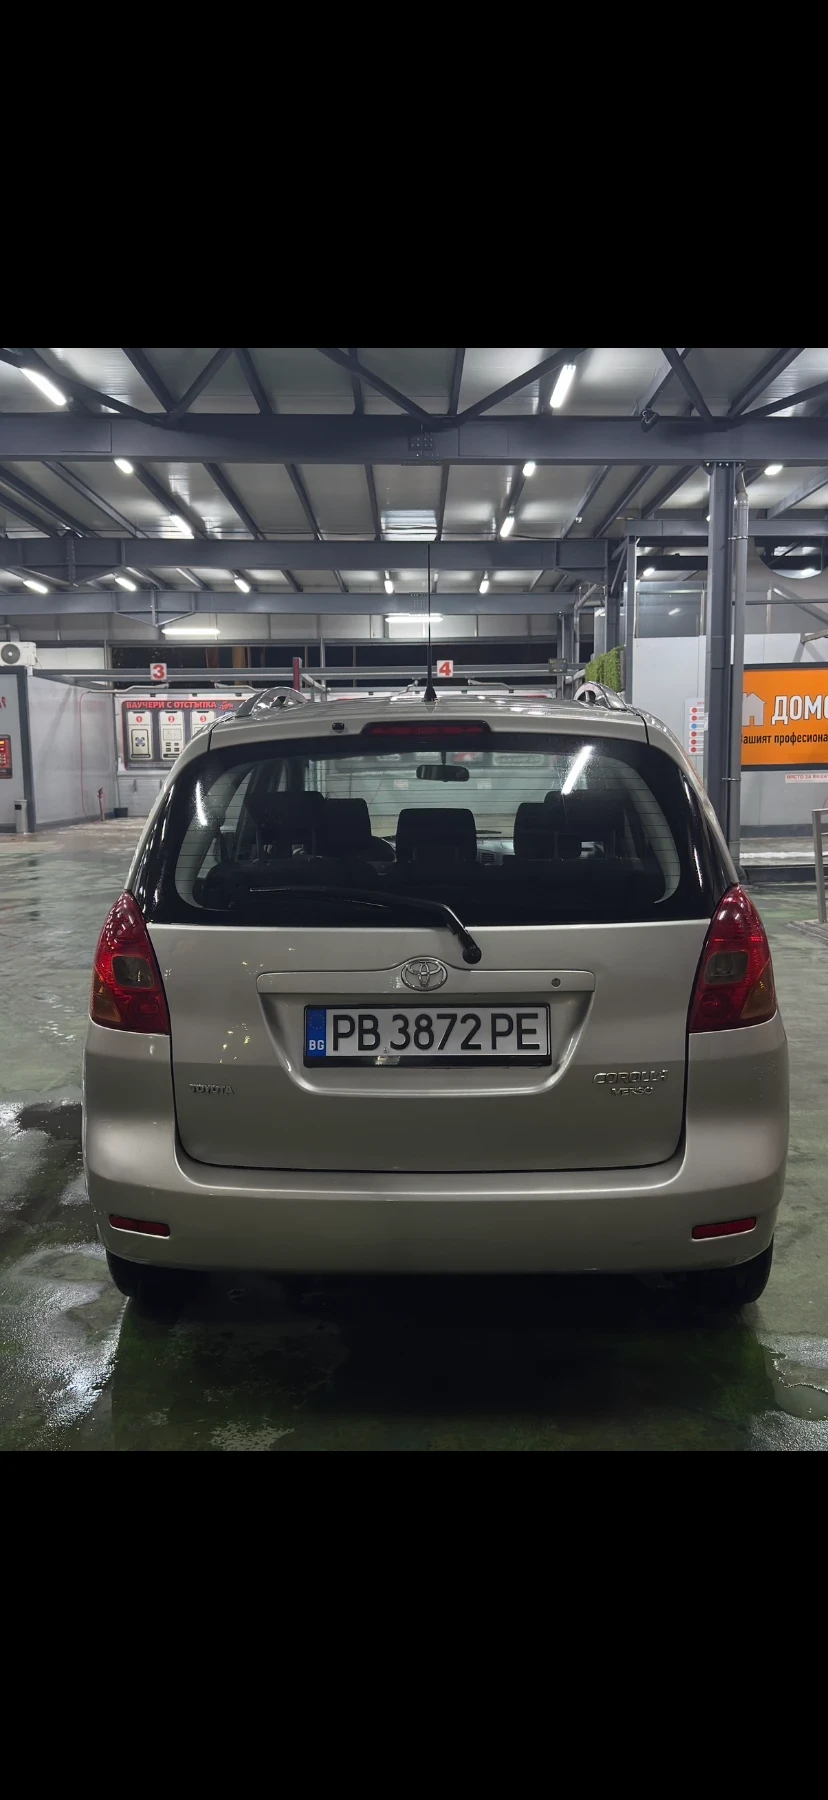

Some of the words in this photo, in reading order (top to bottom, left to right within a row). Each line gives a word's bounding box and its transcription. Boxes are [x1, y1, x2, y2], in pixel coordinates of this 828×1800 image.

[153, 665, 165, 679] 3
[440, 662, 452, 675] 4
[126, 701, 165, 709] ВАУЧЕРИ
[174, 701, 217, 709] ОТСТЪПКА
[741, 735, 771, 744] ашият
[309, 1040, 324, 1051] BG
[332, 1014, 380, 1052] PB
[389, 1013, 482, 1051] 3872
[490, 1012, 540, 1050] PE
[189, 1083, 235, 1095] TOYOTA
[610, 1085, 654, 1096] VERSO
